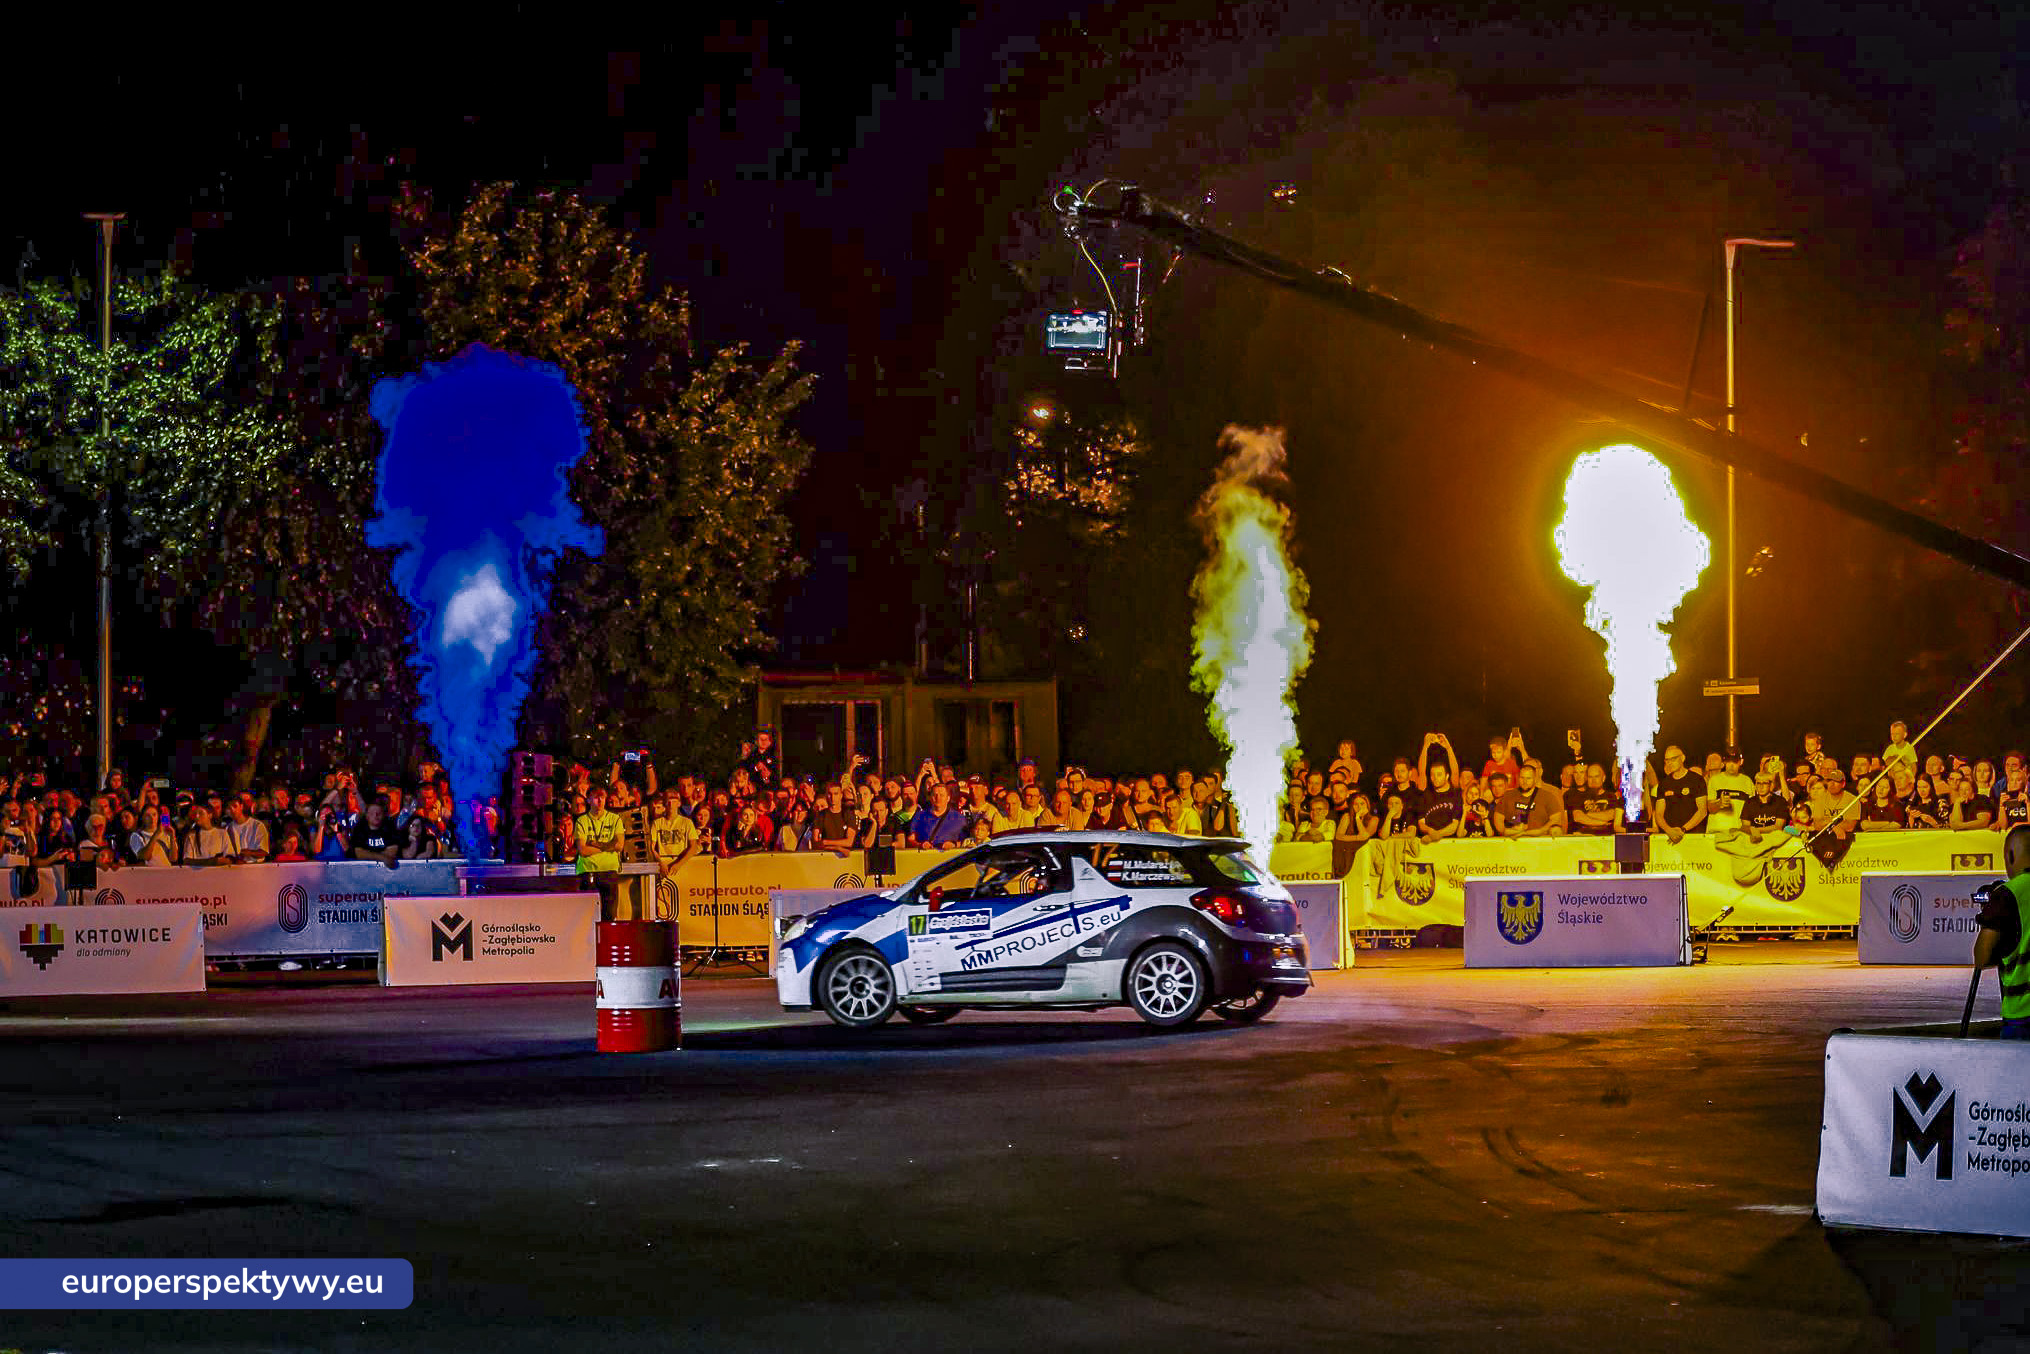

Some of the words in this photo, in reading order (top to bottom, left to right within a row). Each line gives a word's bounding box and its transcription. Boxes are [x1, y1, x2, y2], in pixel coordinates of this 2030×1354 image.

[1088, 842, 1120, 869] 17
[1447, 863, 1527, 876] Województwo
[689, 883, 782, 900] superauto.
[1556, 891, 1648, 907] Województwo
[318, 909, 368, 924] STADION
[689, 903, 739, 917] STADION
[910, 915, 925, 935] 17
[1556, 910, 1604, 927] Śląskie
[75, 927, 172, 944] KATOWICE
[481, 923, 542, 935] Górnośląsko
[76, 947, 91, 958] dla
[92, 946, 132, 958] odmiany
[482, 946, 535, 958] Metropolia
